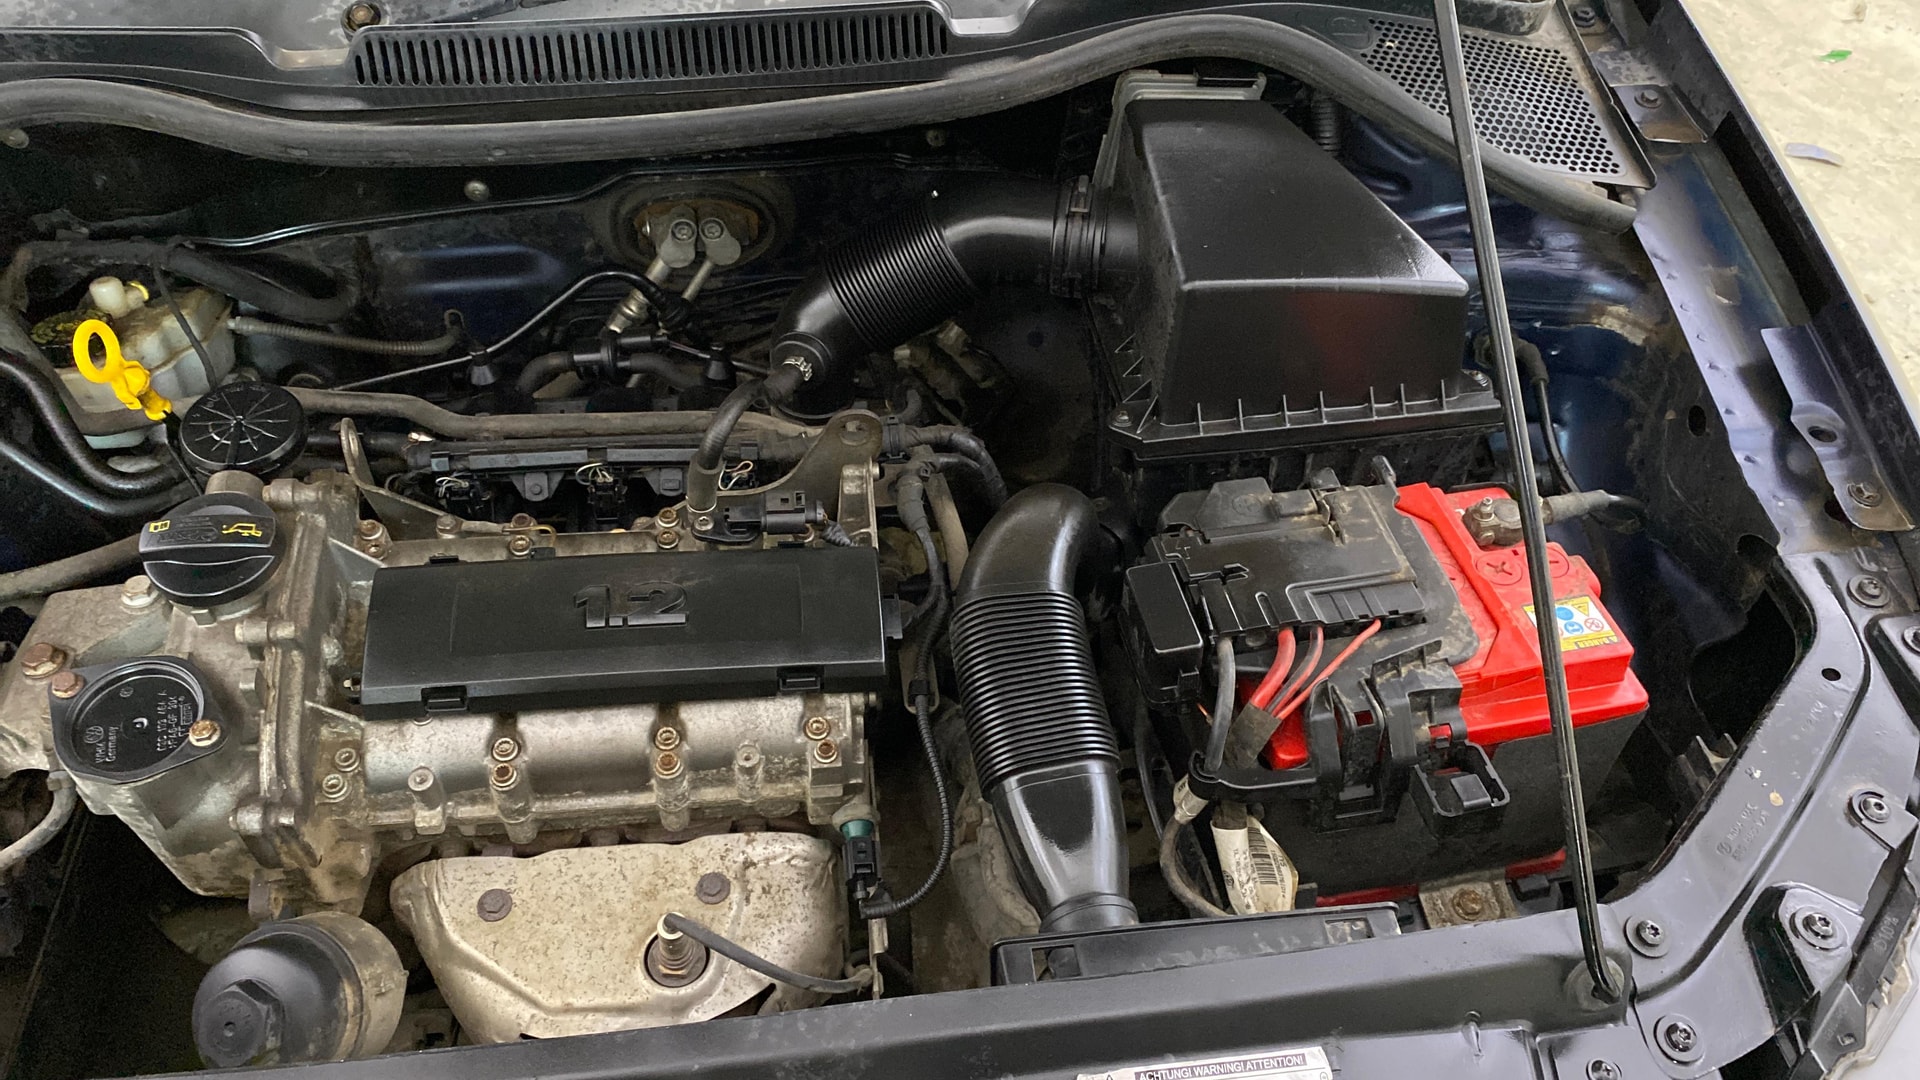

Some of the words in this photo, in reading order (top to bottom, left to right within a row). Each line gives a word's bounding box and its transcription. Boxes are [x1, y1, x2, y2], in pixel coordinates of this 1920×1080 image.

[573, 580, 688, 629] 1.2
[1139, 1067, 1193, 1080] ACHTUNG!
[1193, 1062, 1245, 1077] WARNING!
[1246, 1055, 1304, 1072] ATTENTION!
